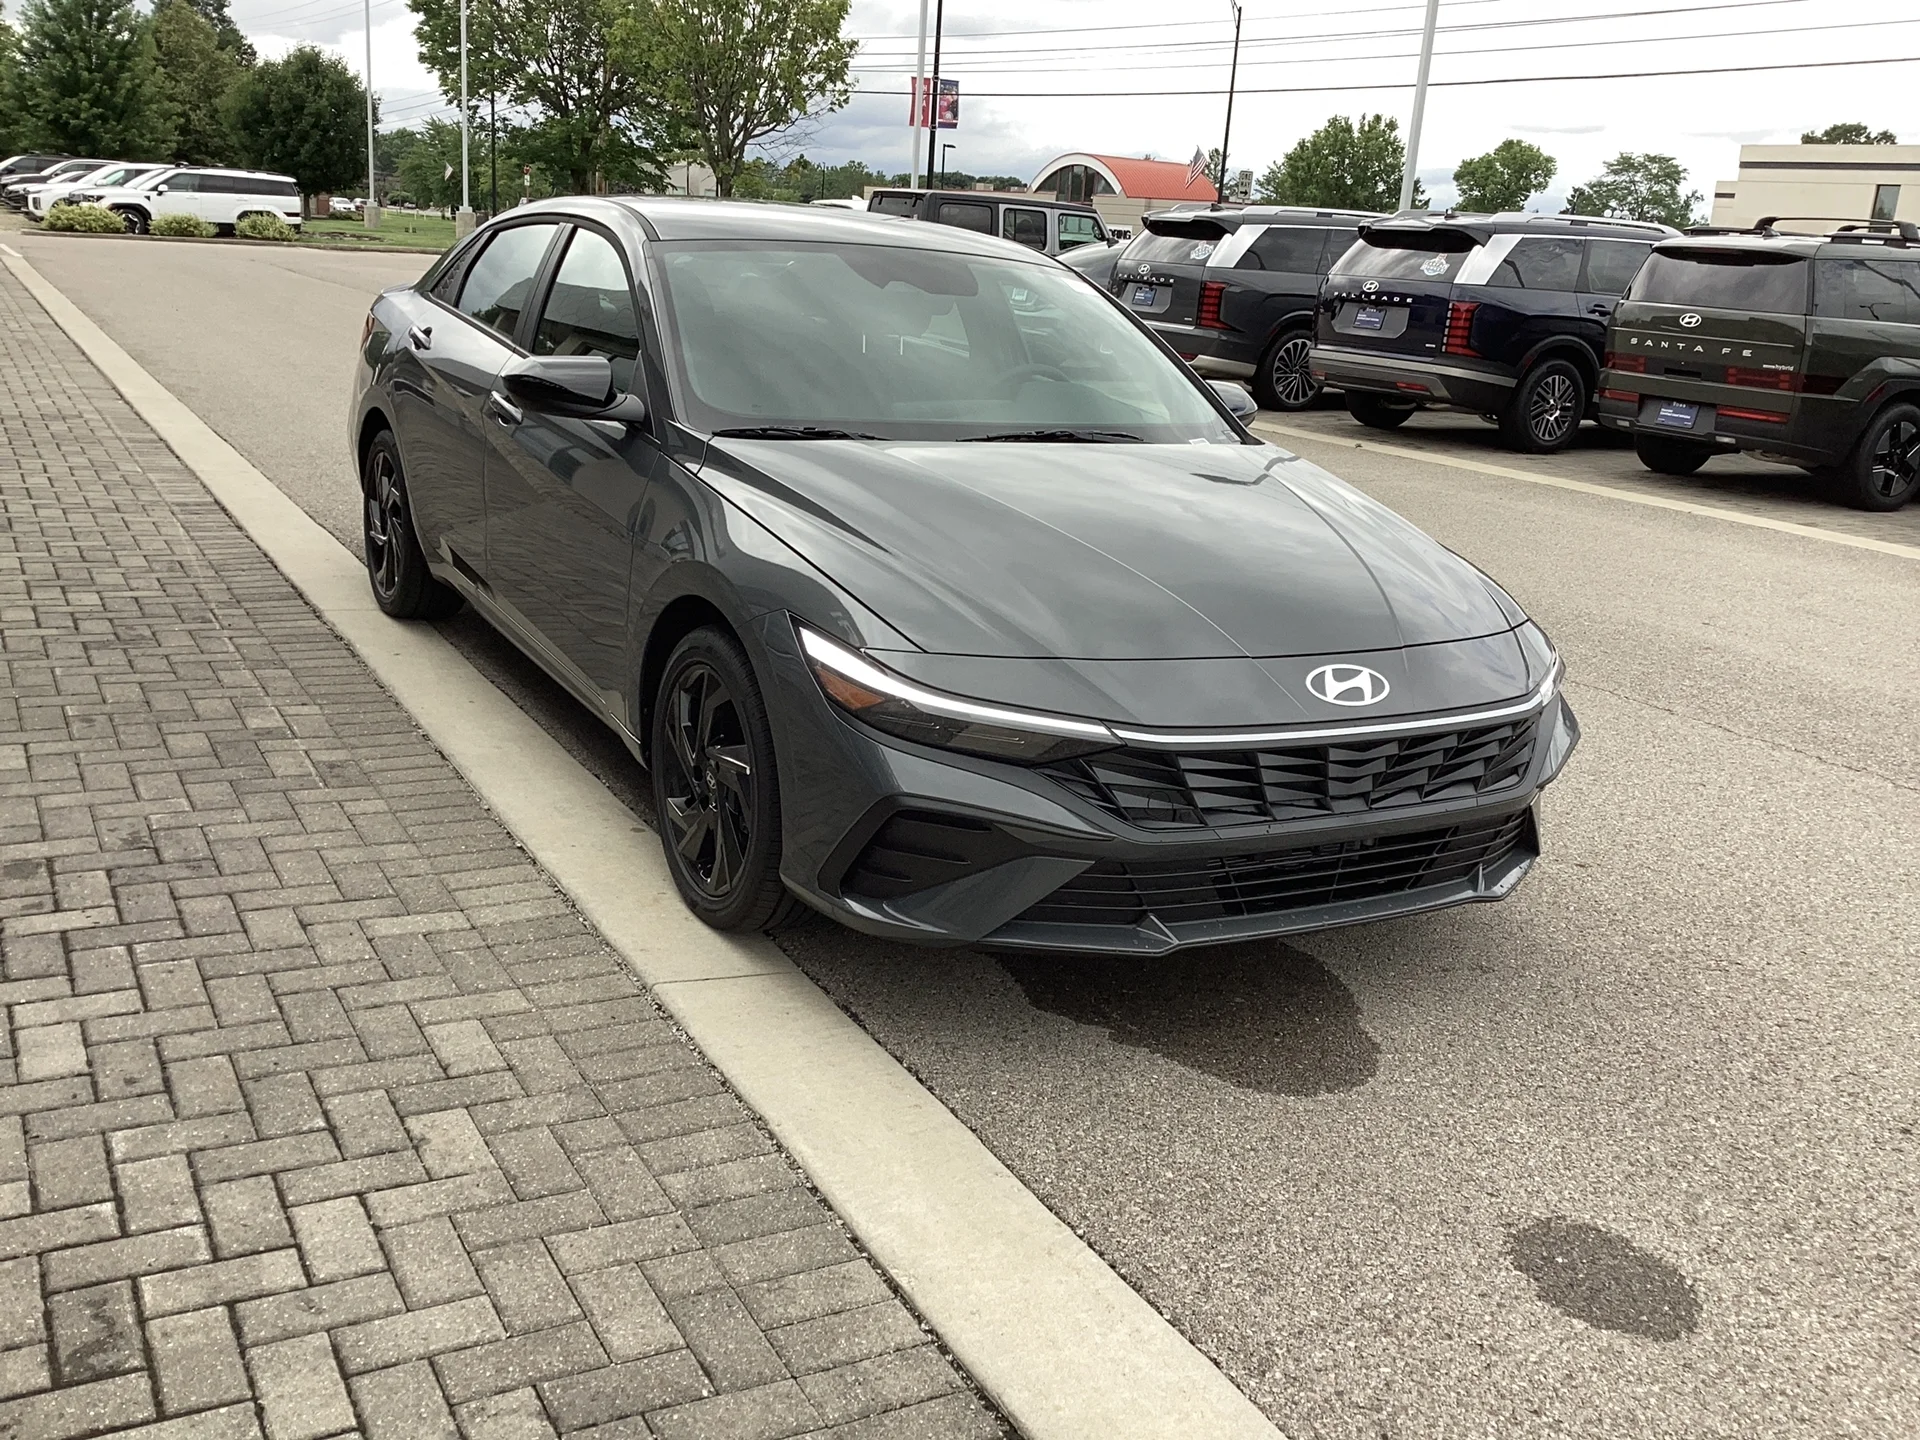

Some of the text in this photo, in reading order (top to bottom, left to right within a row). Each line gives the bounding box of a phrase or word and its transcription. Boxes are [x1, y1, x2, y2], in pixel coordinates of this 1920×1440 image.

[1118, 273, 1175, 284] PALISADE
[1333, 291, 1414, 304] PALISADE
[1629, 337, 1753, 357] SANTA FE
